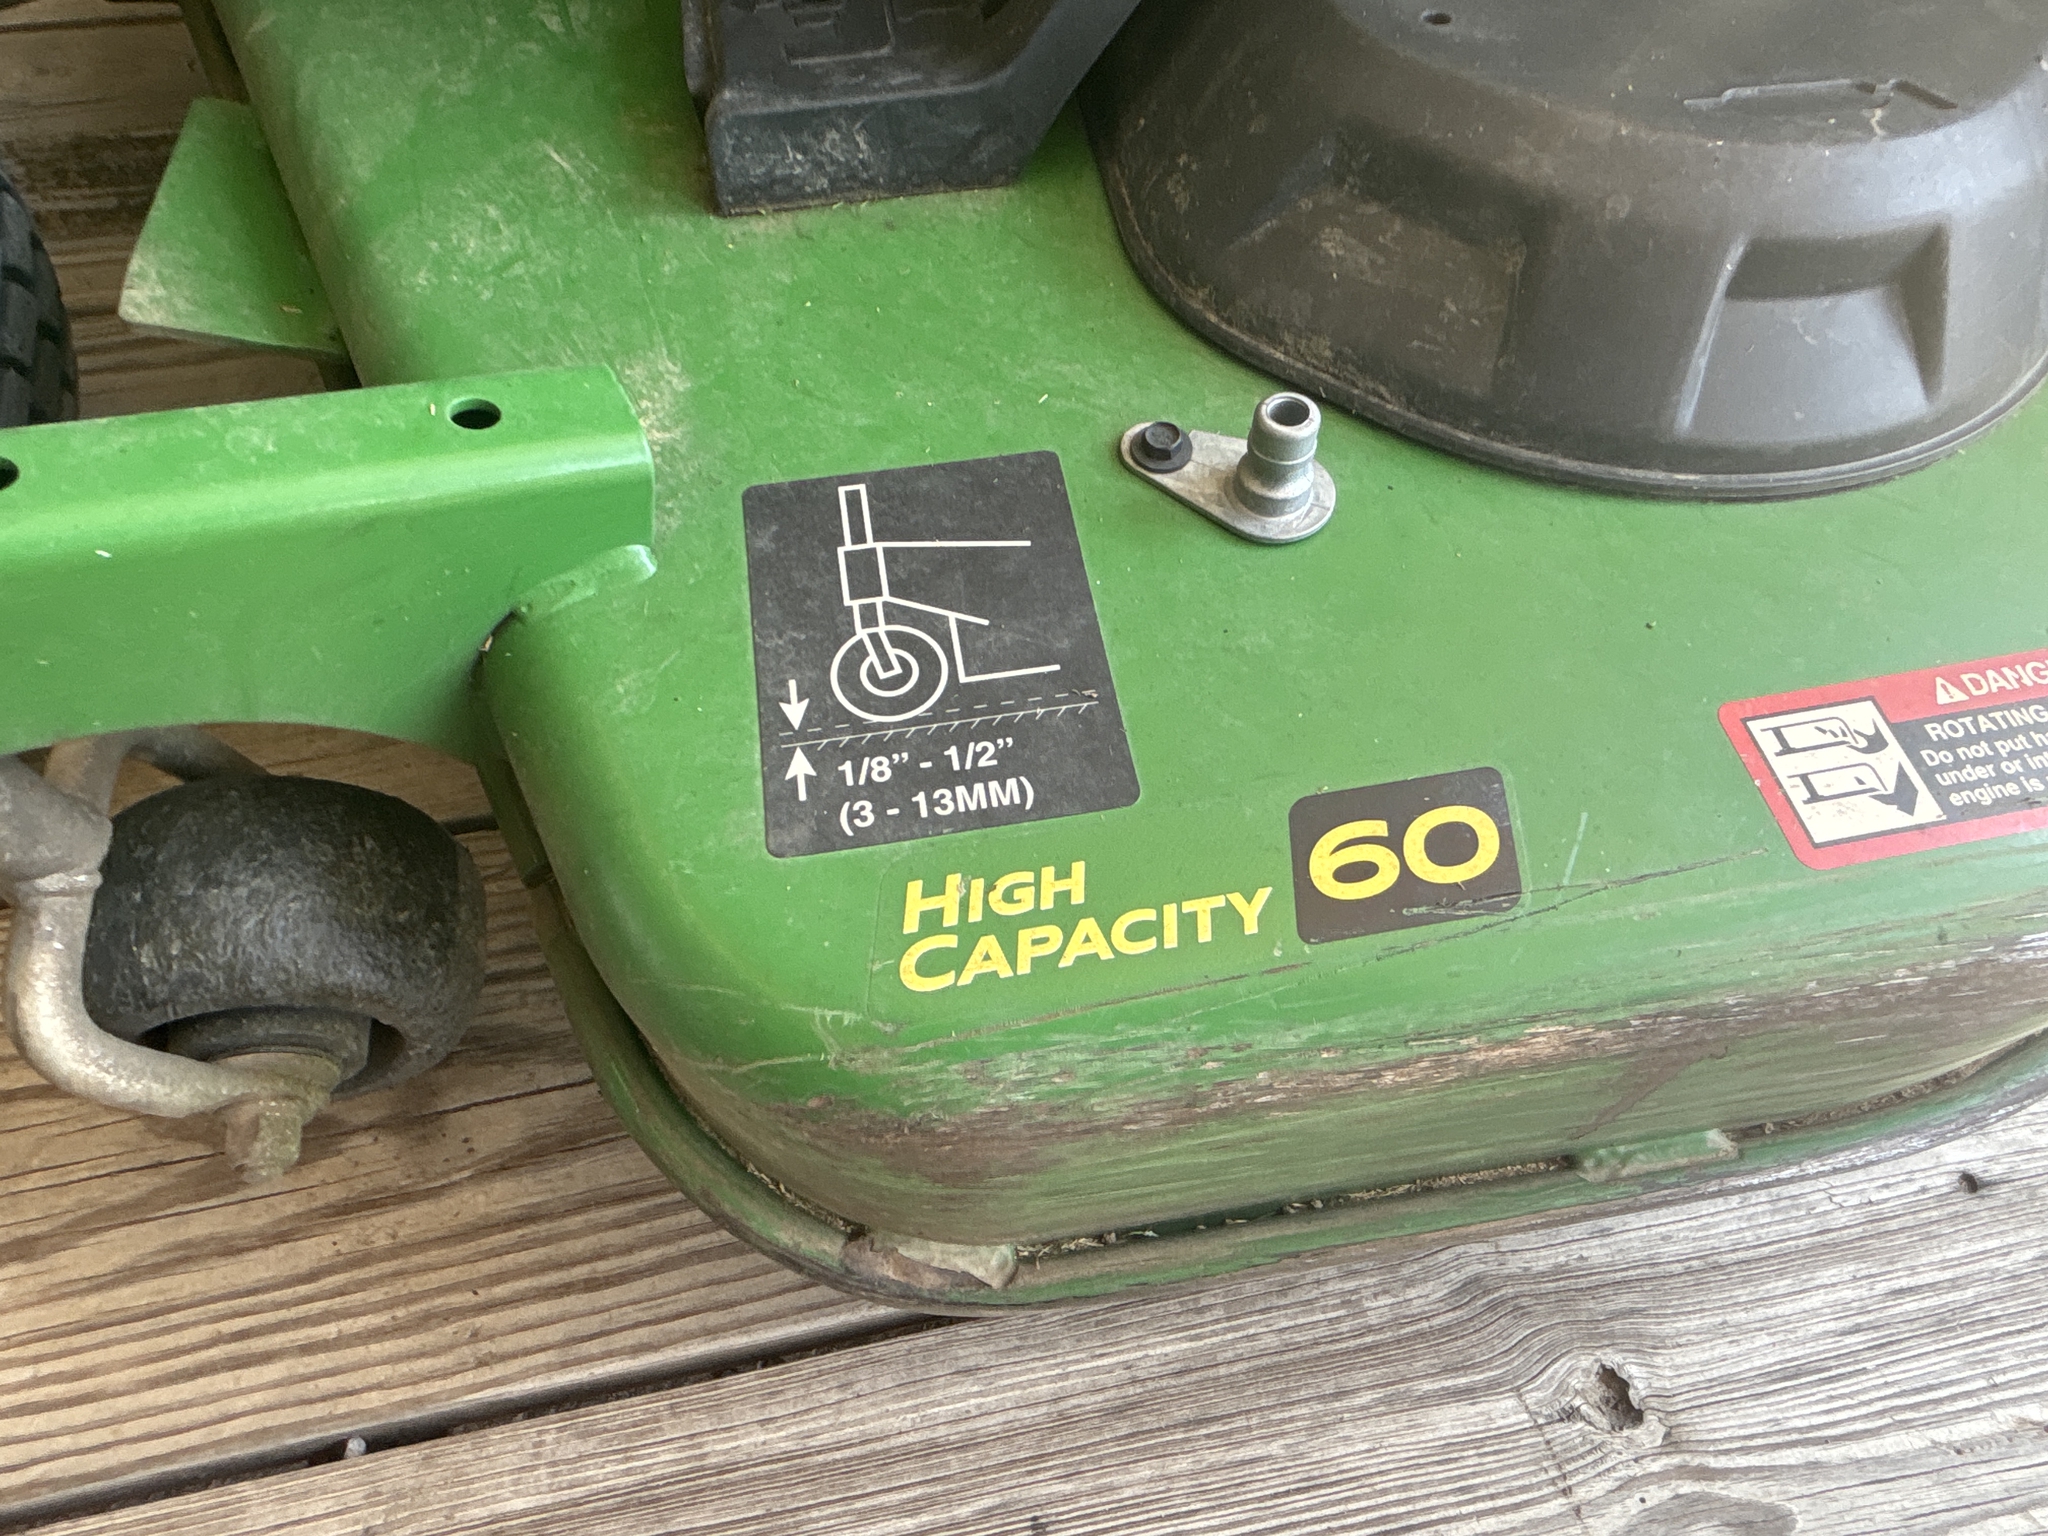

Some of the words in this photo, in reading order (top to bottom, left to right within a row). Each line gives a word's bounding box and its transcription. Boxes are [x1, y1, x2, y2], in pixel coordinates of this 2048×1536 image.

[1960, 660, 2048, 696] DANG
[1924, 705, 2048, 741] ROTATING
[1920, 749, 1954, 767] Do
[1956, 741, 1994, 760] not
[1993, 734, 2033, 758] put
[1934, 764, 1996, 786] under
[2000, 758, 2024, 774] or
[839, 800, 875, 836] (3
[911, 776, 1035, 818] 13MM)
[1949, 783, 2021, 806] engine
[2020, 776, 2045, 792] is
[1309, 804, 1500, 901] 60
[902, 860, 1086, 934] HIGH
[899, 886, 1273, 992] CAPACITY
